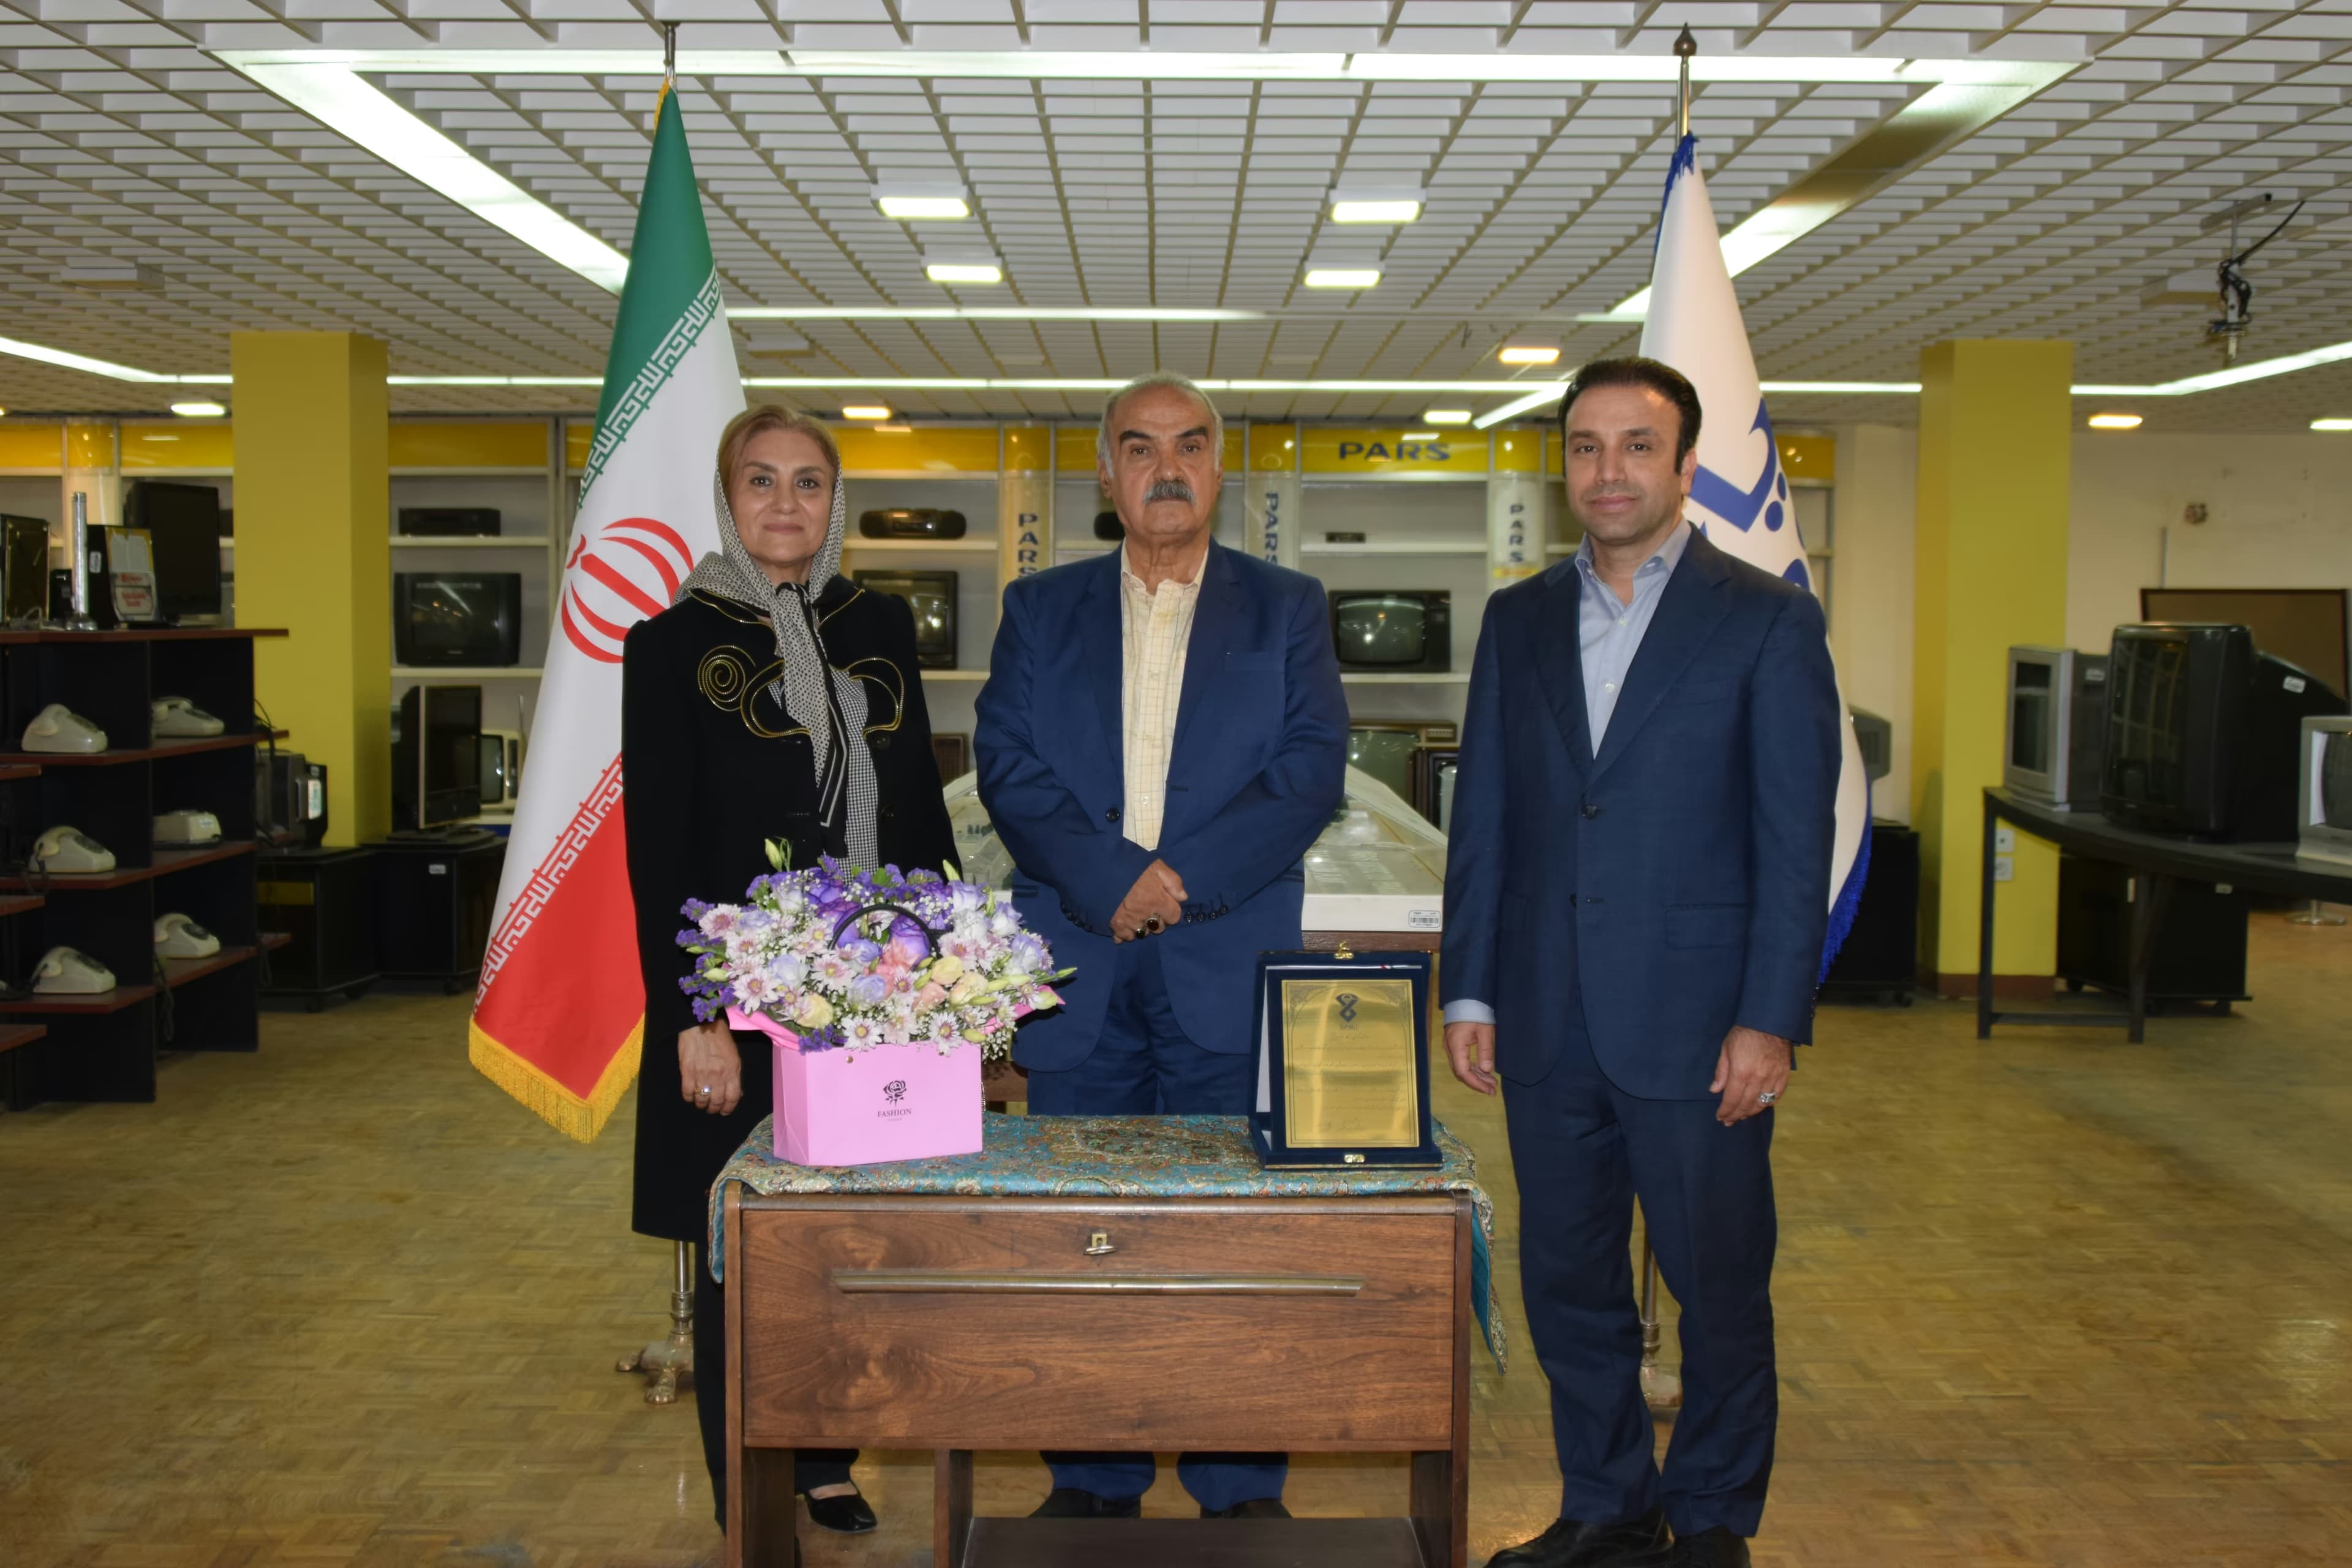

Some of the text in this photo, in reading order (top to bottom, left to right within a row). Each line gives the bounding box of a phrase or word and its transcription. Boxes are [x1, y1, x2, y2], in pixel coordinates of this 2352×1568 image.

[1339, 442, 1450, 461] PARS
[1509, 503, 1525, 563] PARS
[877, 1107, 911, 1118] FASHION
